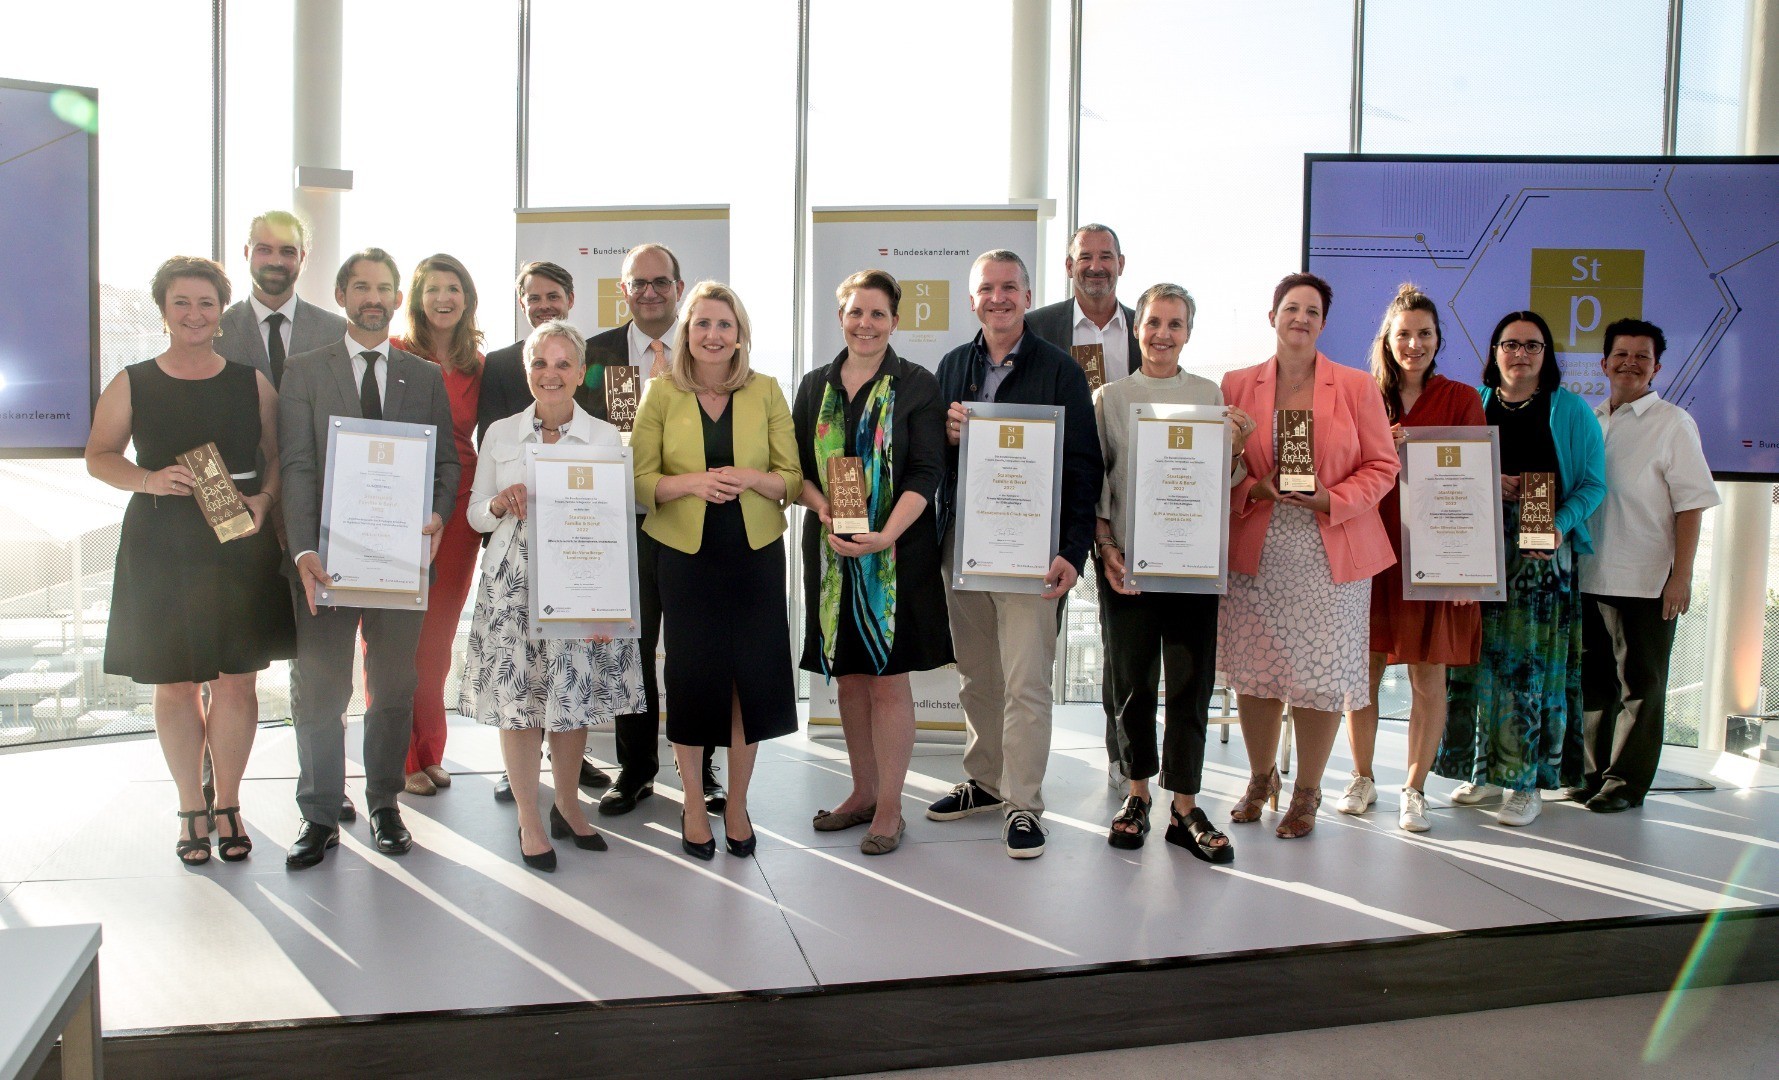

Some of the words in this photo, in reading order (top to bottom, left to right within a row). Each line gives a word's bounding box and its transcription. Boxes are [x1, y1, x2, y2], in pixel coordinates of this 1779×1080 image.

[893, 248, 970, 256] Bundeskanzleramt
[1571, 255, 1602, 281] St
[915, 283, 930, 297] St
[615, 300, 630, 325] p
[915, 302, 931, 328] p
[1568, 295, 1602, 346] p
[1560, 359, 1601, 369] Staatspre
[0, 410, 71, 420] skanzleramt
[1007, 435, 1015, 447] p
[1176, 435, 1184, 447] p
[1445, 455, 1453, 466] p
